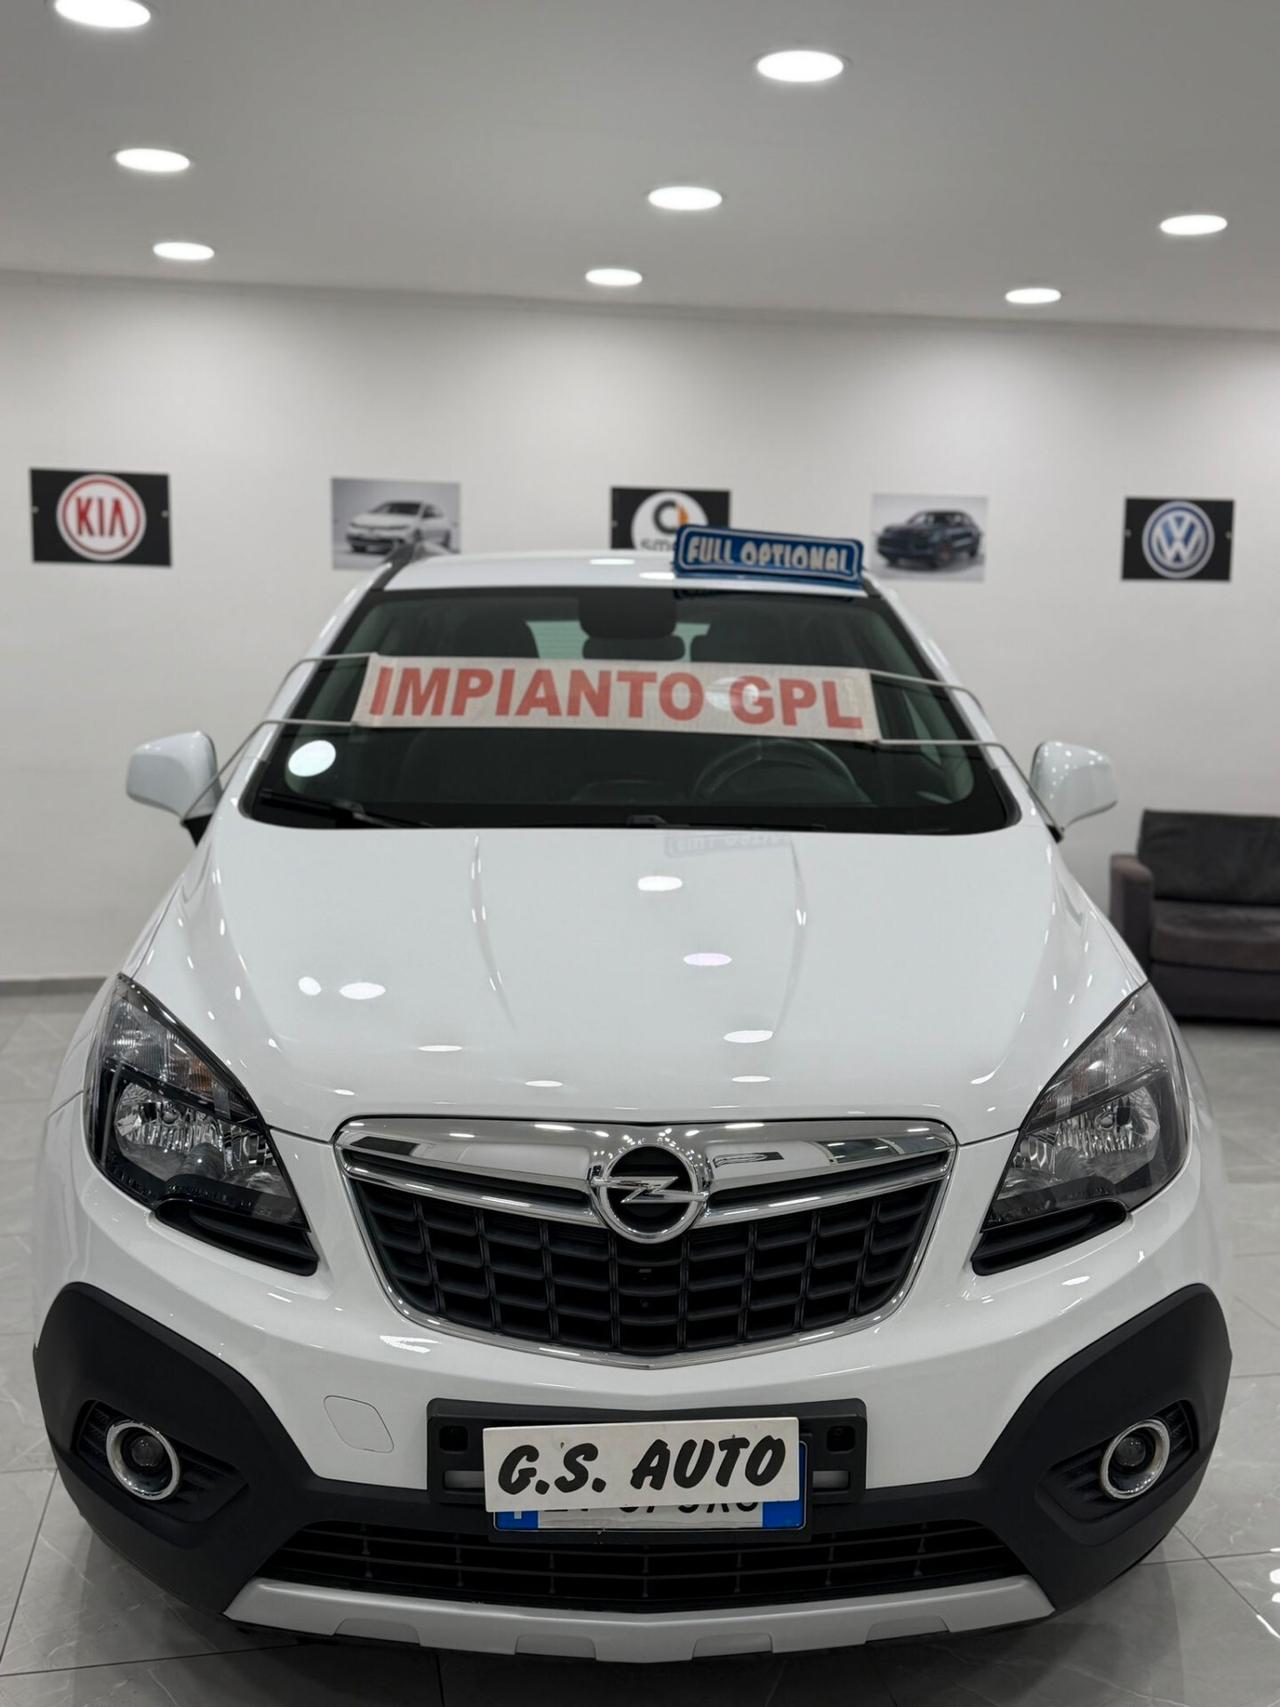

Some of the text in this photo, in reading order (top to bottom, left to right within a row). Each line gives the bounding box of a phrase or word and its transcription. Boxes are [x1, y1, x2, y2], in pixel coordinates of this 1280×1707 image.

[76, 496, 128, 538] KIA
[688, 536, 851, 573] FULL OPTIONAL
[368, 666, 864, 729] IMPIANTO GPL
[498, 1434, 786, 1495] G.S. AUTO
